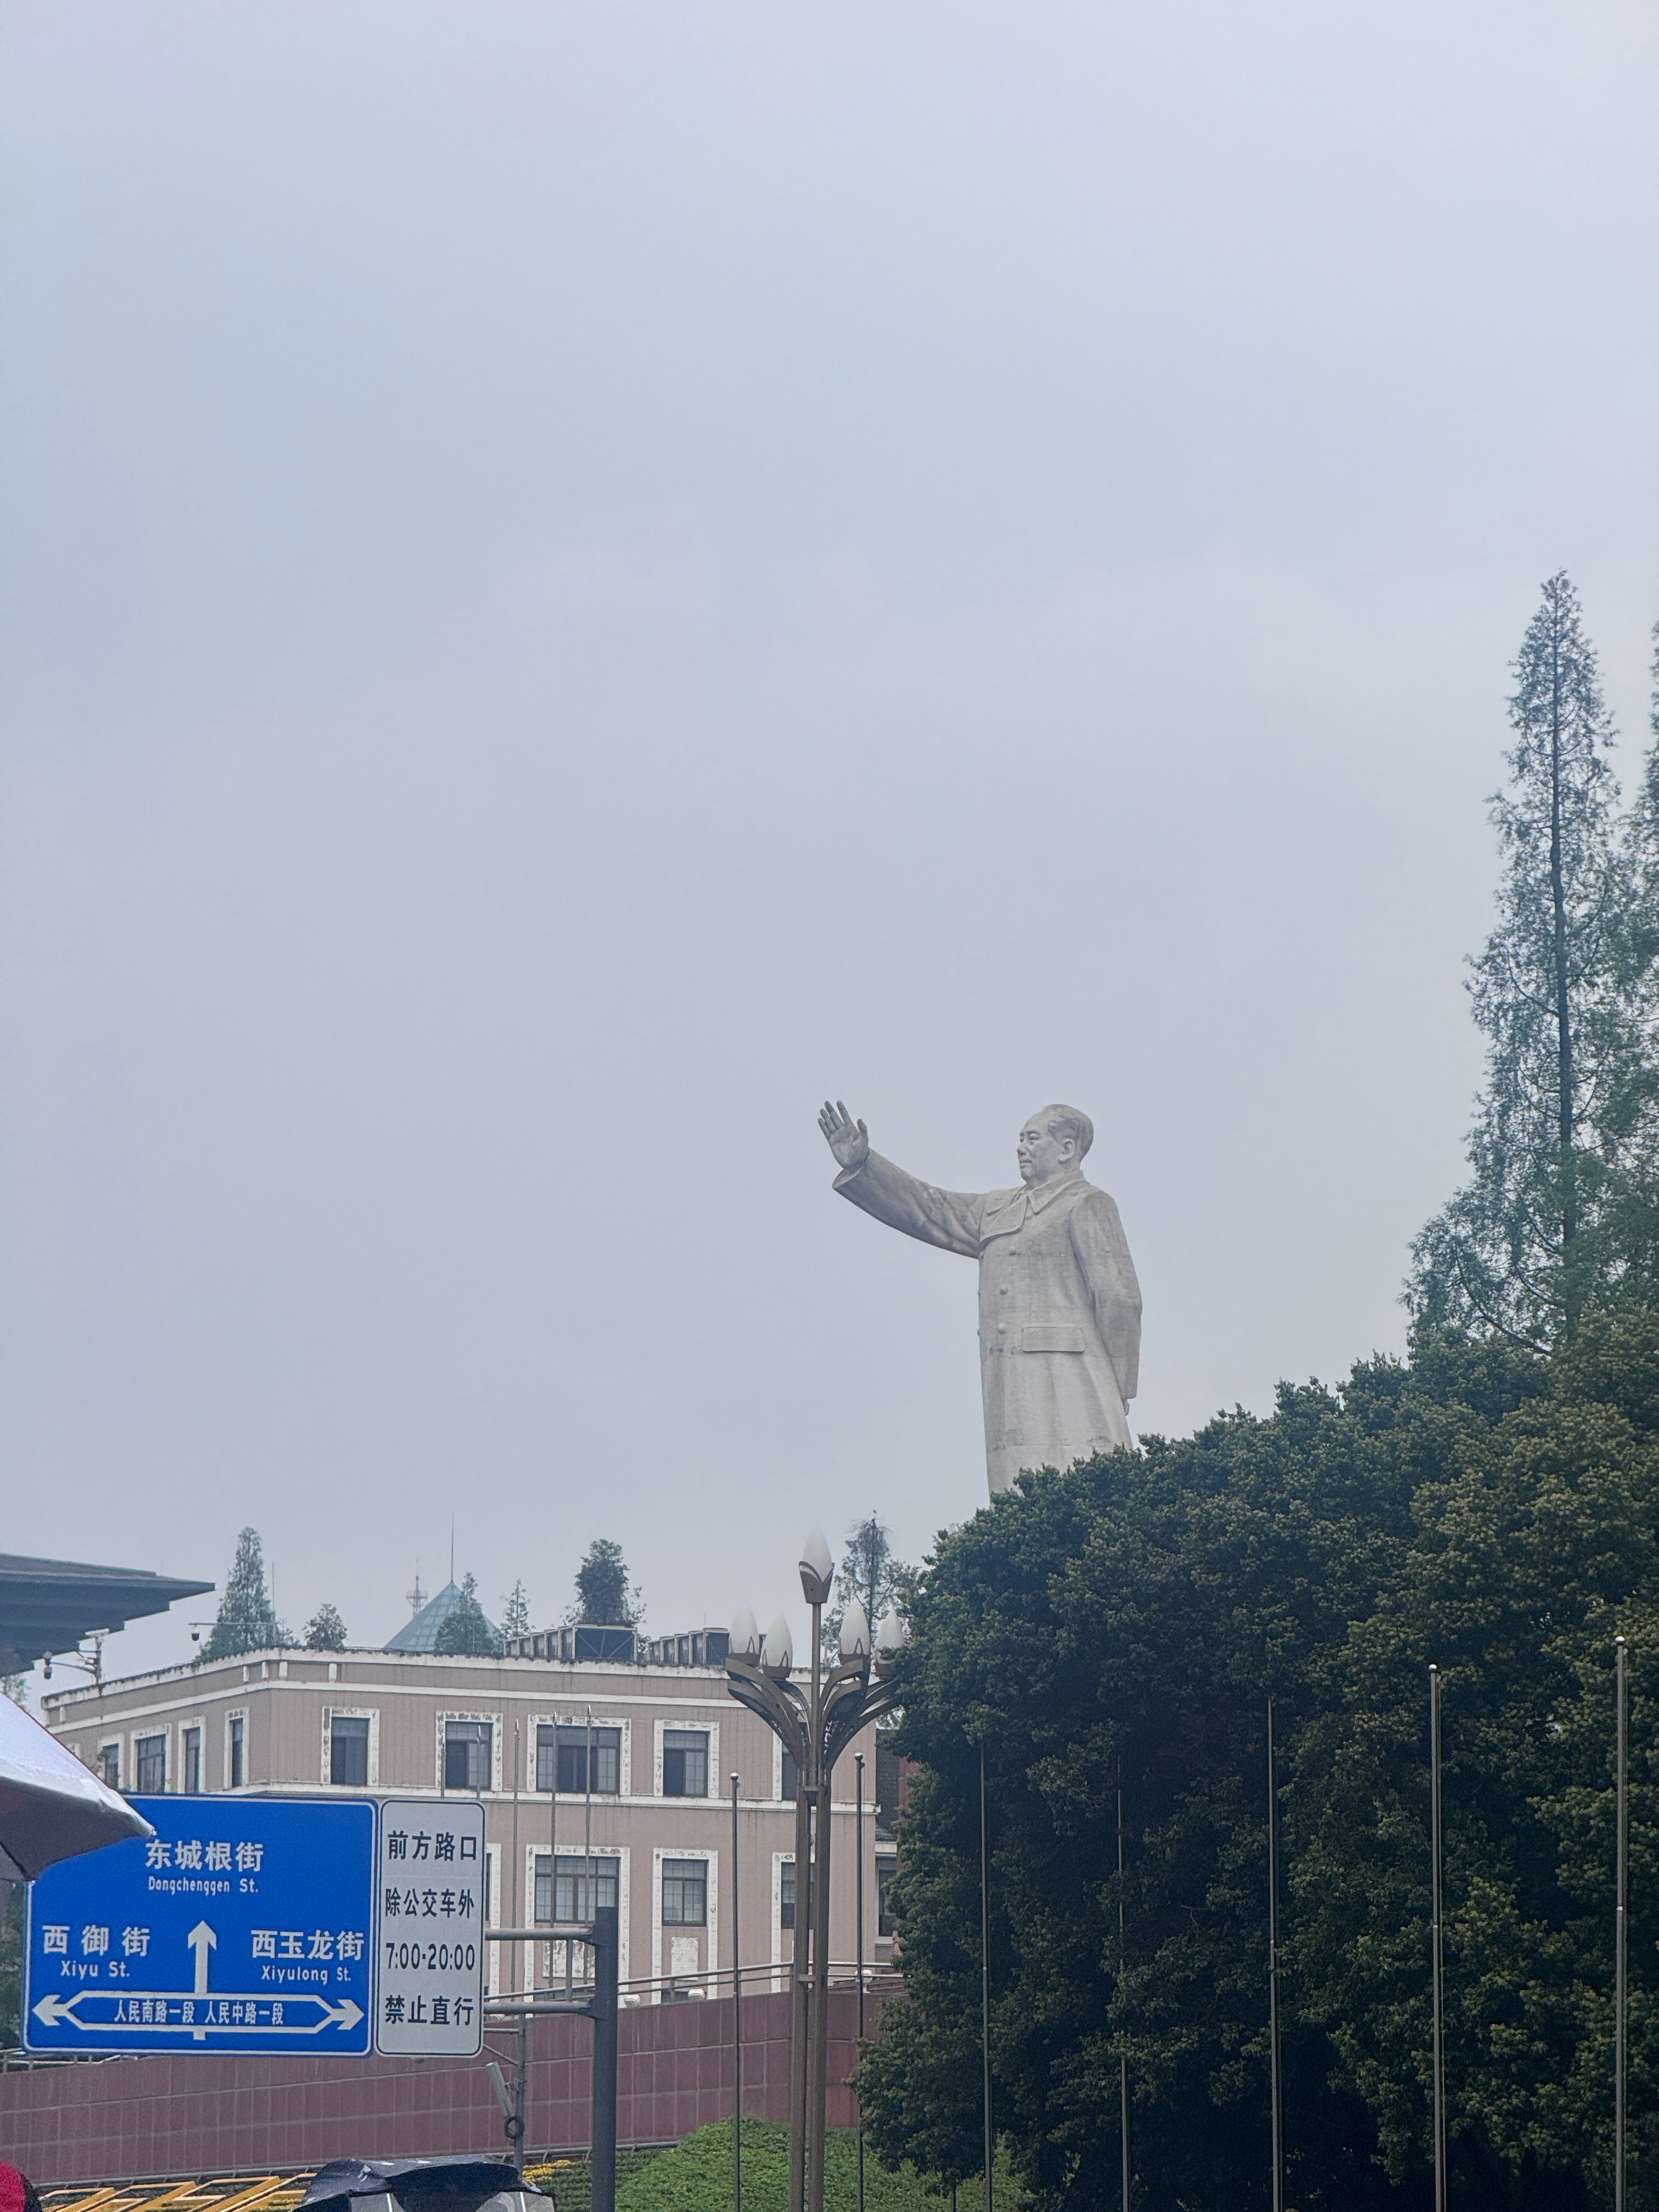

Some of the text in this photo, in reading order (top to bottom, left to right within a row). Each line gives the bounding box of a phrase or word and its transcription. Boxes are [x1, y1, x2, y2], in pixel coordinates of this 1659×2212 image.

[146, 1839, 263, 1872] 东城根街
[388, 1831, 477, 1861] 前方路口
[149, 1876, 258, 1895] Dongchenggen St.
[385, 1887, 475, 1918] 除公交车外
[43, 1925, 150, 1956] 西御街
[251, 1929, 364, 1961] 西玉龙街
[60, 1960, 130, 1980] Xiyu St.
[386, 1942, 475, 1971] 7:00-20:00
[261, 1965, 352, 1985] Xiyulong St.
[114, 2000, 284, 2025] 人民南路一段 人民中路一段
[385, 1995, 474, 2025] 禁止直行
